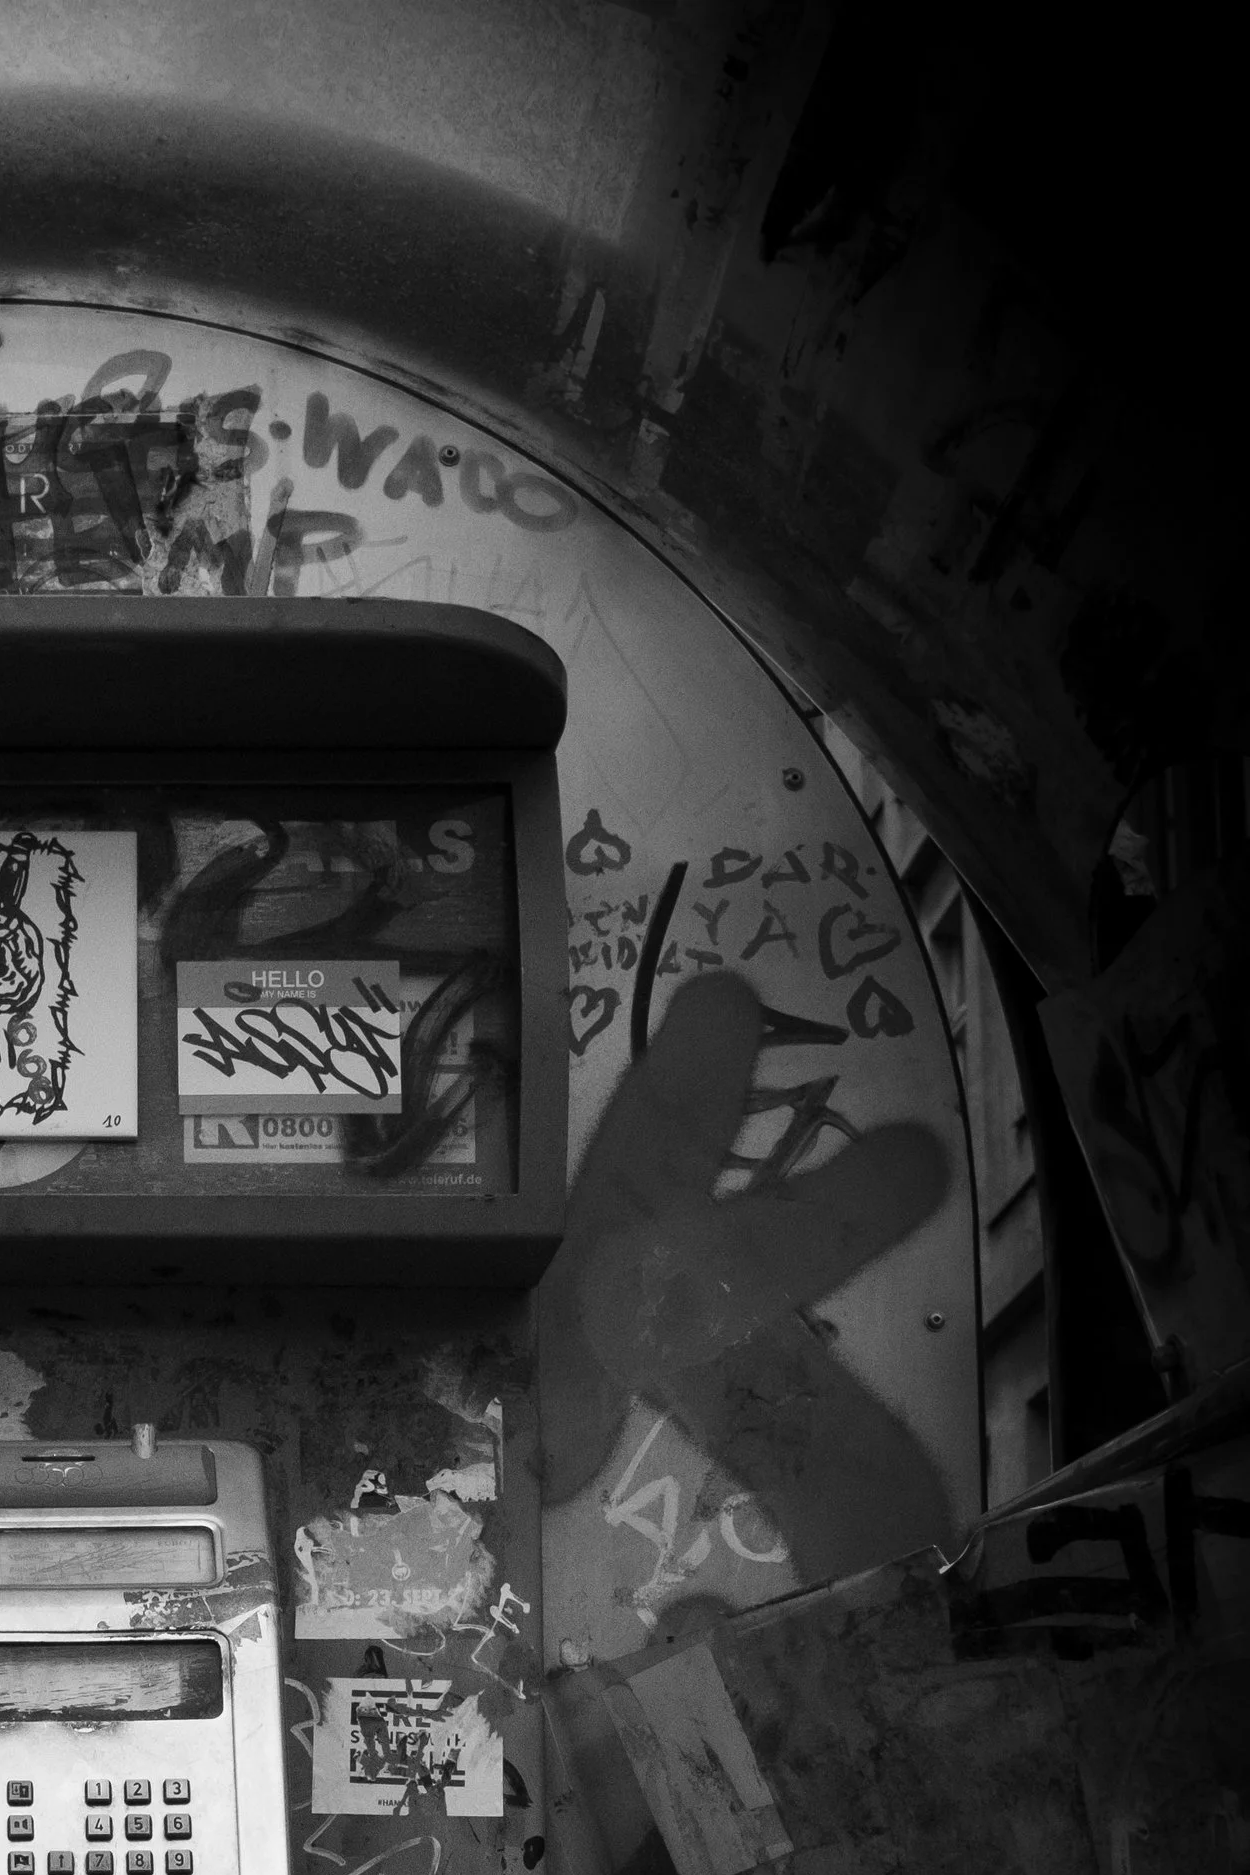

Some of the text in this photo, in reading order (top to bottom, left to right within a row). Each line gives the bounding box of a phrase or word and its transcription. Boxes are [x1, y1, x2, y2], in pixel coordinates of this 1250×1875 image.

[251, 969, 325, 988] HELLO
[260, 990, 317, 998] MY NAME IS
[102, 1114, 122, 1128] 10
[262, 1117, 334, 1138] 0800
[95, 1782, 182, 1796] 1 2 3
[94, 1817, 183, 1831] 4 5 6
[94, 1853, 184, 1867] 7 8 9
